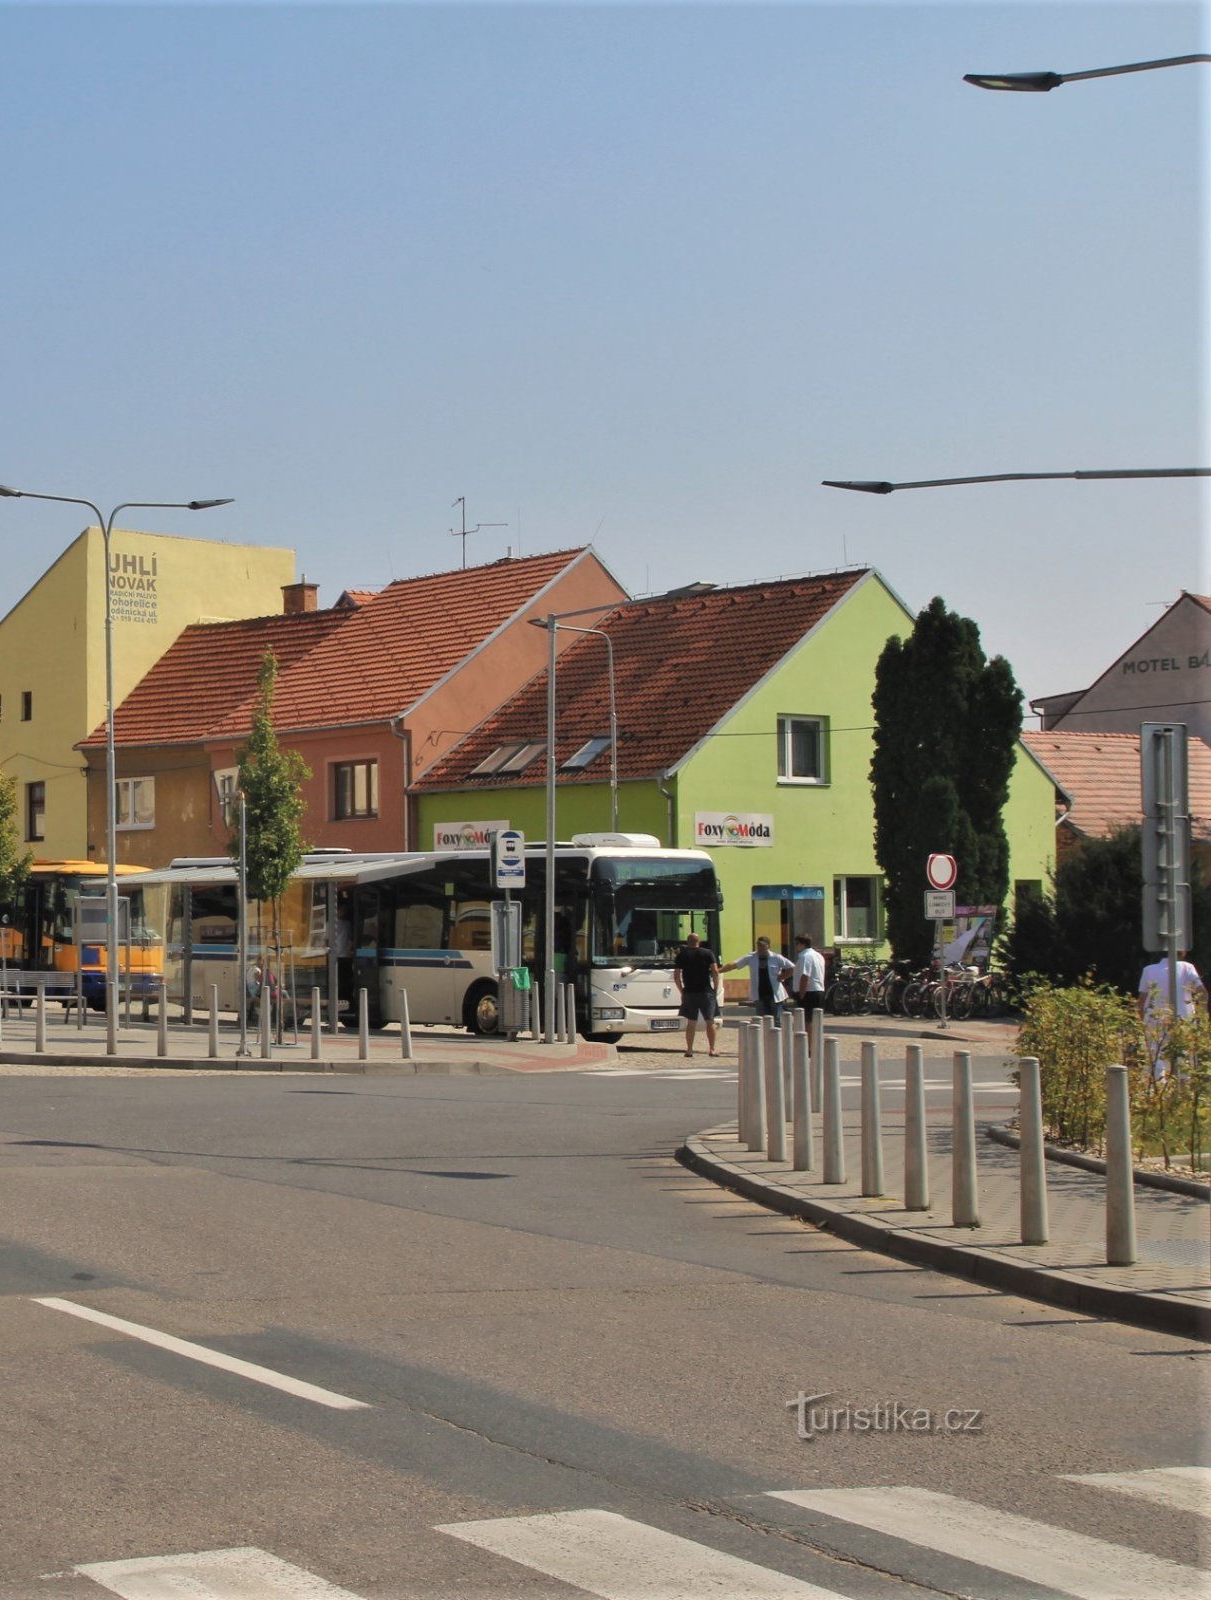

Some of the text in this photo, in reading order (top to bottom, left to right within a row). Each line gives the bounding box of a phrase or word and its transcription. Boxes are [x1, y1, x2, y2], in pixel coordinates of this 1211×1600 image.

[108, 552, 157, 577] UHLÍ
[110, 607, 147, 617] oděnická
[1123, 658, 1180, 675] MOTEL
[436, 828, 491, 847] Foxy Mó
[697, 821, 770, 839] Foxy Móda
